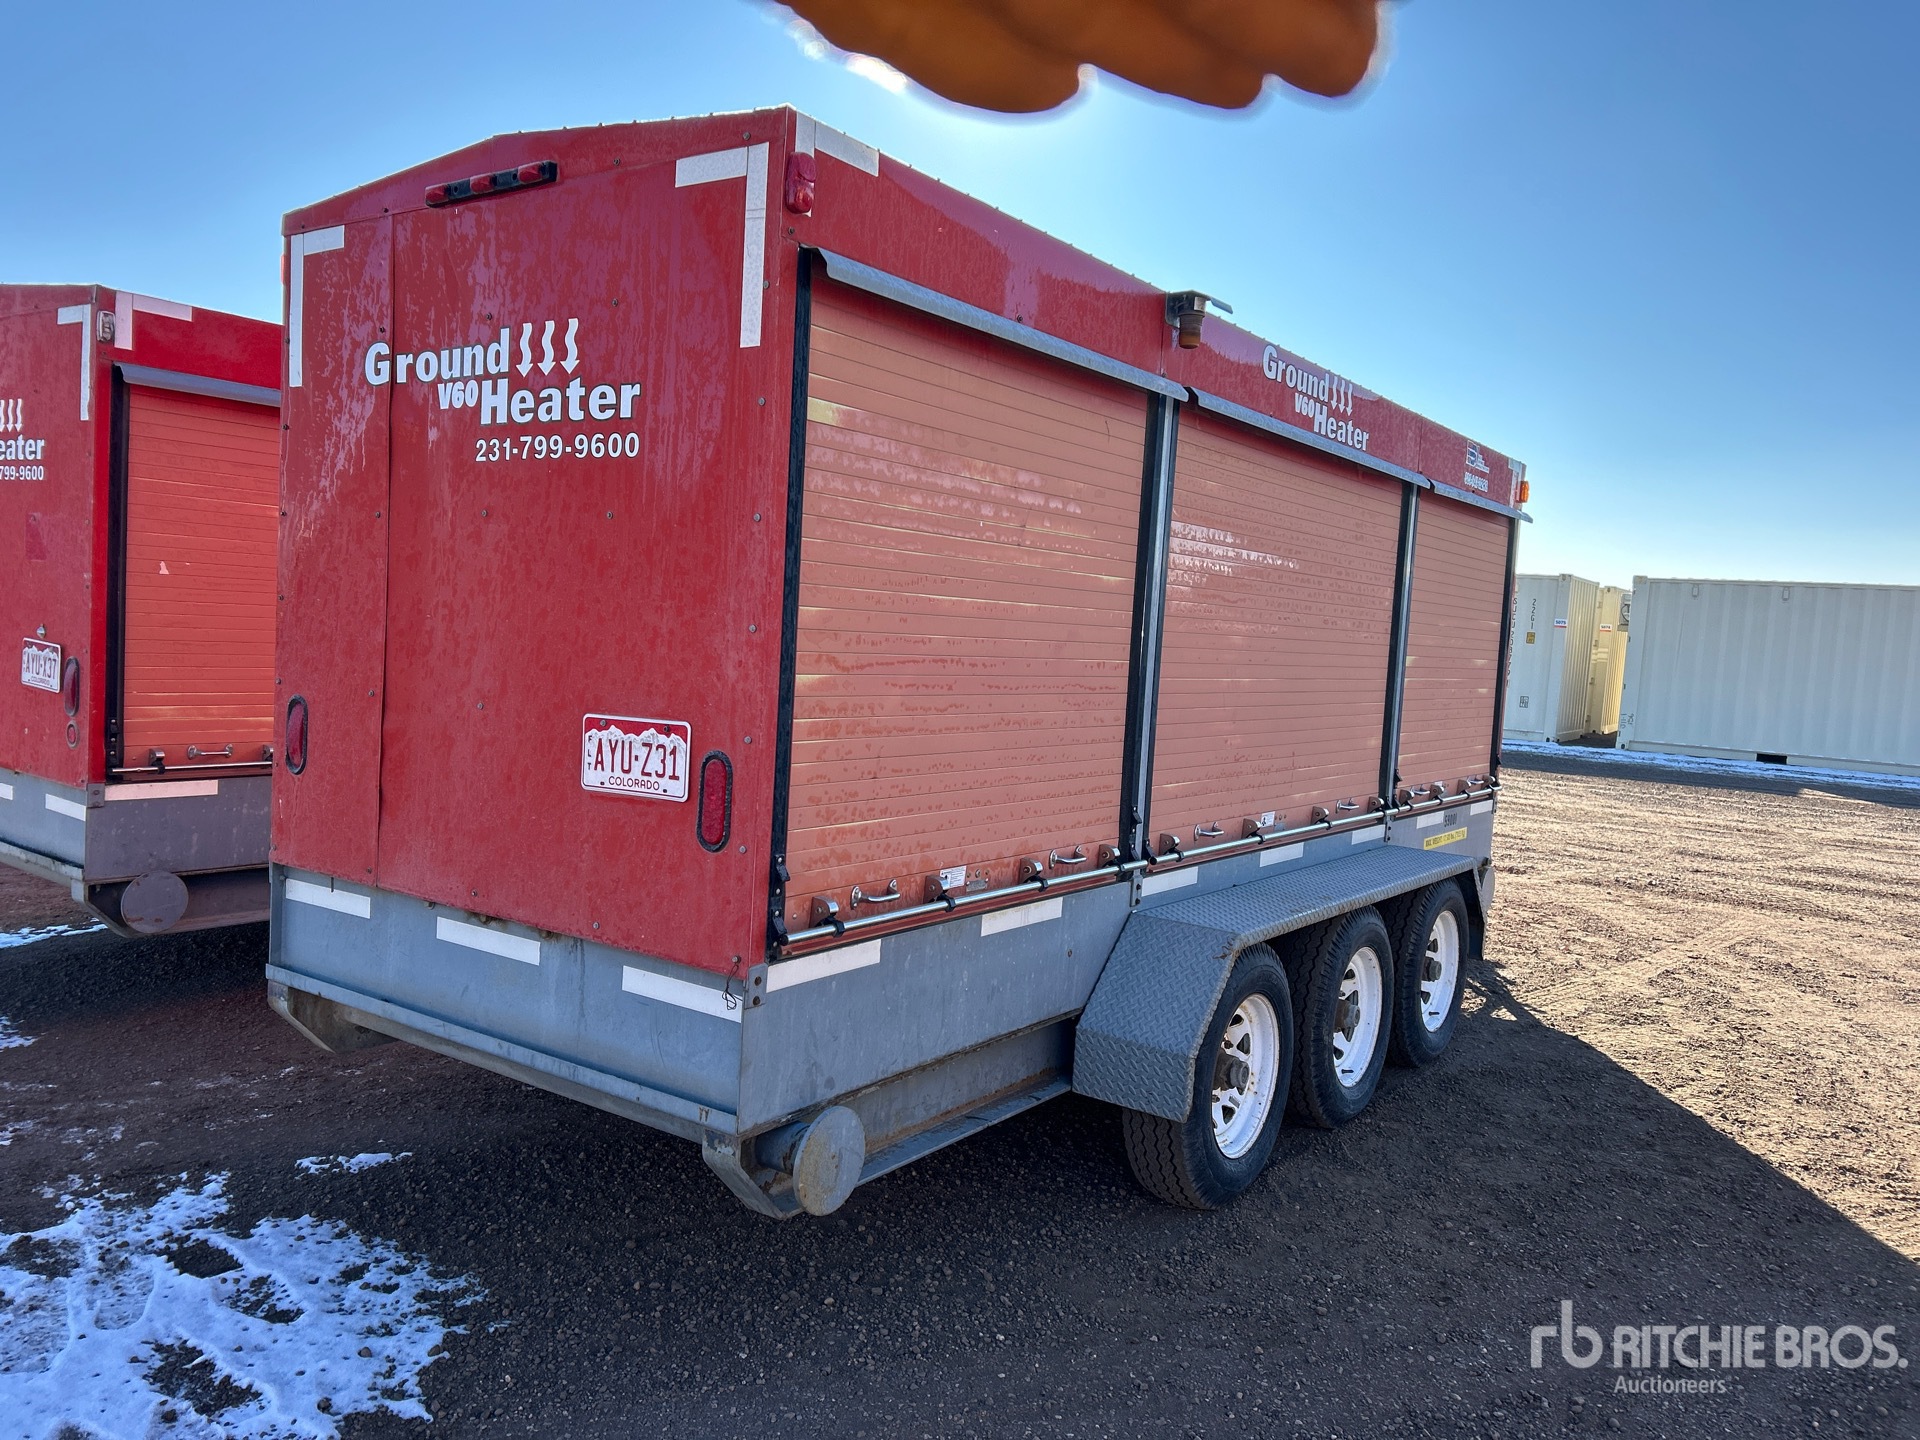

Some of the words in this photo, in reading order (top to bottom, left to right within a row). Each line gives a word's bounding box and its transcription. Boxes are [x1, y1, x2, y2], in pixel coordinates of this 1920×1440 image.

[365, 327, 510, 386] Ground
[1263, 345, 1330, 402] Ground
[437, 380, 479, 410] V60
[480, 376, 641, 425] Heater
[1294, 392, 1315, 418] V60
[1313, 402, 1369, 451] Heater
[475, 432, 640, 462] 231-799-9600
[25, 652, 58, 680] AYU-X37
[593, 737, 680, 781] AYU-Z31
[608, 775, 660, 791] COLORADO
